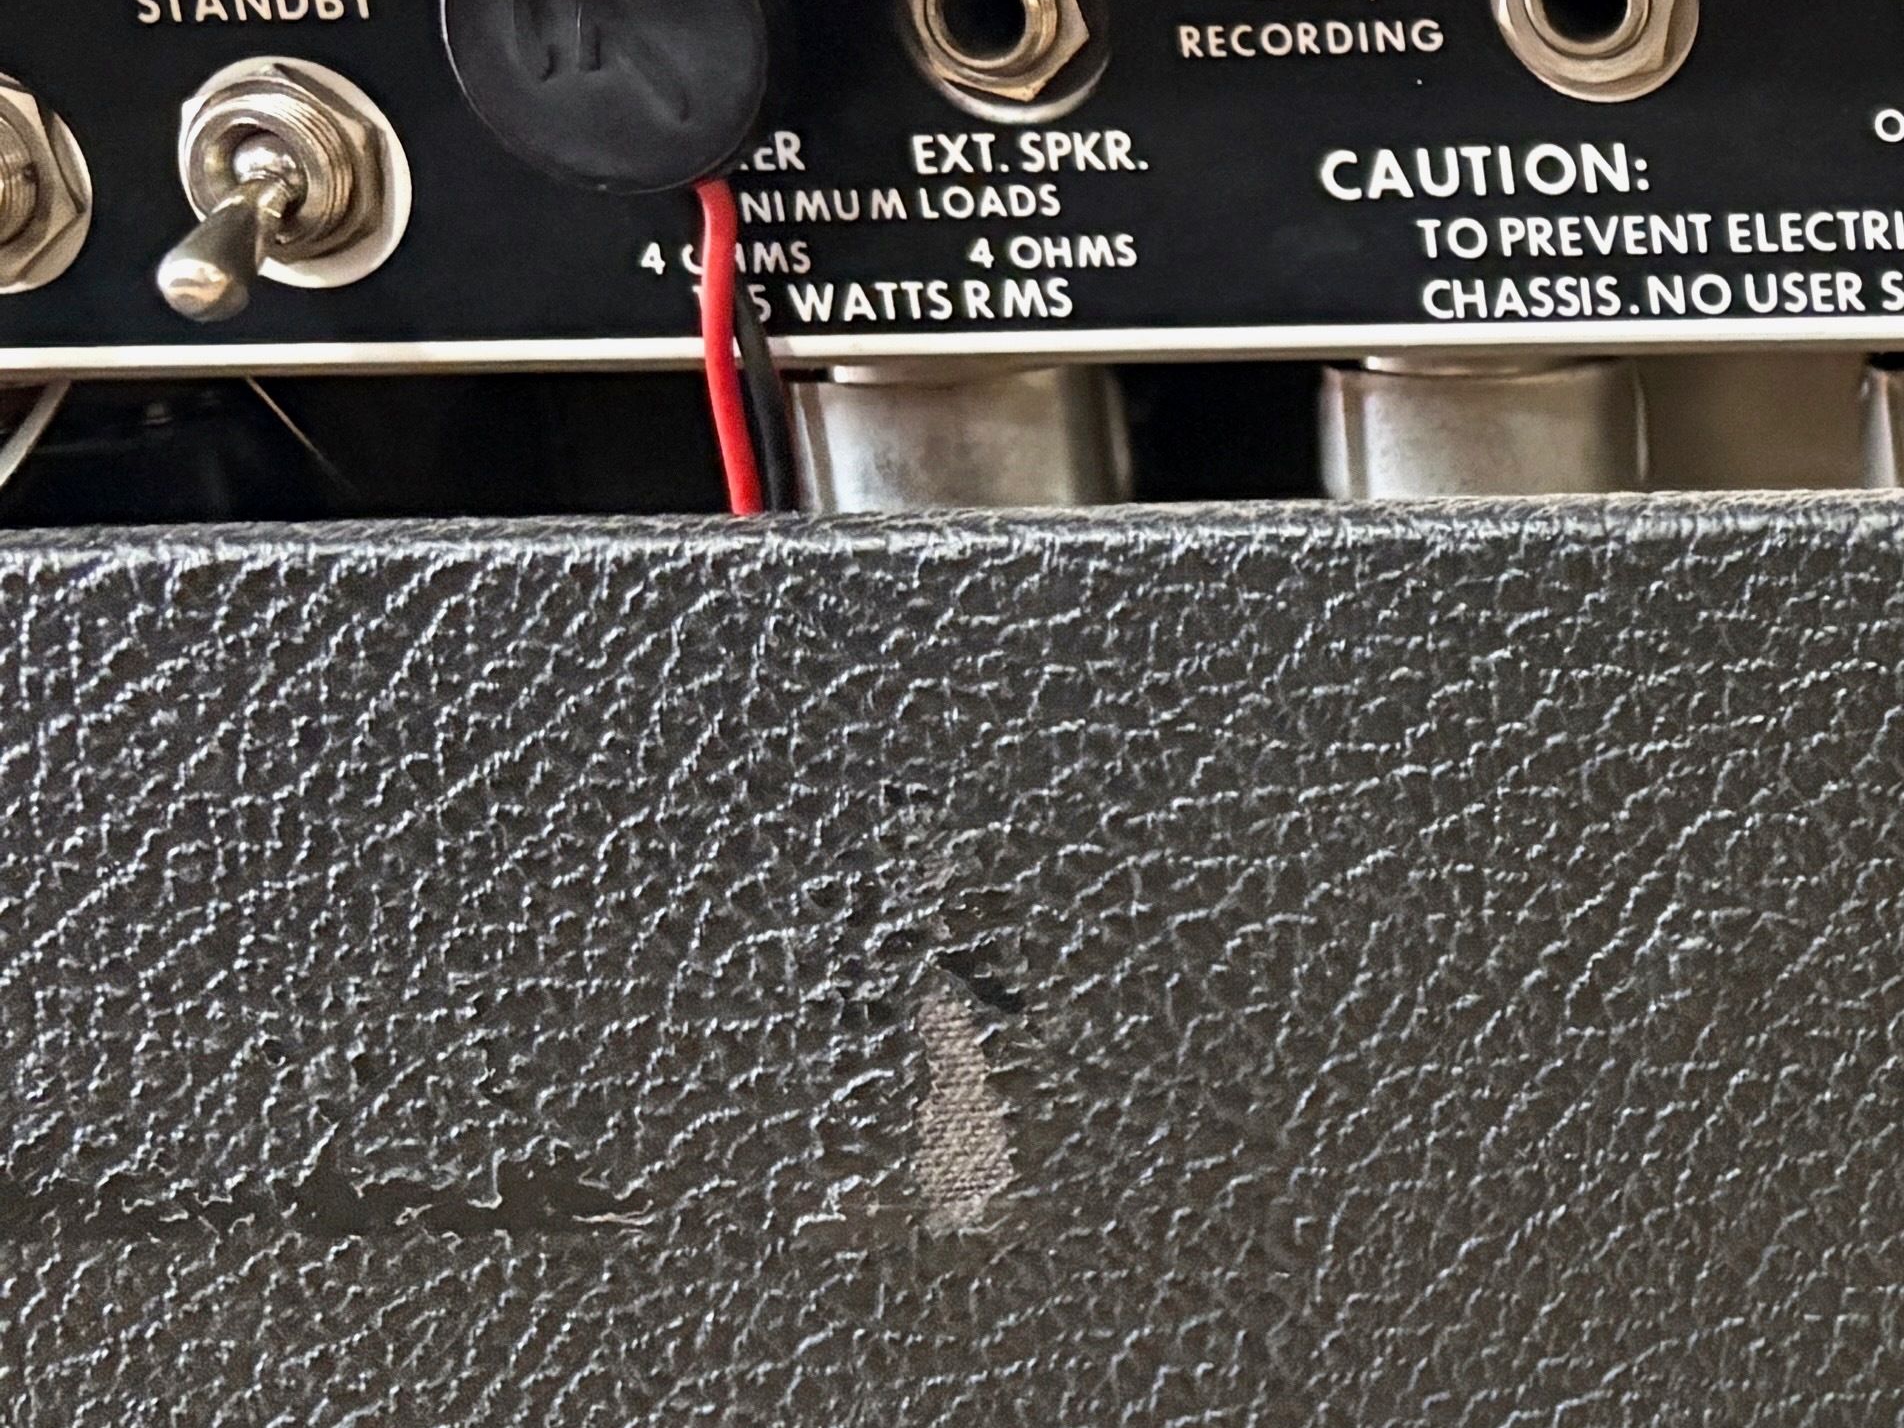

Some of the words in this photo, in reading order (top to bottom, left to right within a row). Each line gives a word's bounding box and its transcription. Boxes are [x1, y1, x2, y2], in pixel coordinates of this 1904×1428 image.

[1179, 19, 1443, 57] RECORDING
[912, 133, 1009, 174] EXT.
[1019, 130, 1148, 172] SPKR.
[1320, 143, 1649, 200] CAUTION:
[741, 188, 907, 222] NIMUM
[919, 184, 1060, 218] LOADS
[969, 238, 994, 268] 4
[1009, 234, 1137, 268] OHMS
[1416, 218, 1487, 258] TO
[1499, 214, 1711, 256] PREVENT
[641, 243, 665, 274] 4
[788, 280, 950, 322] WATTS
[969, 277, 1072, 318] RMS
[1649, 274, 1731, 316] NO
[1746, 272, 1863, 314] USER
